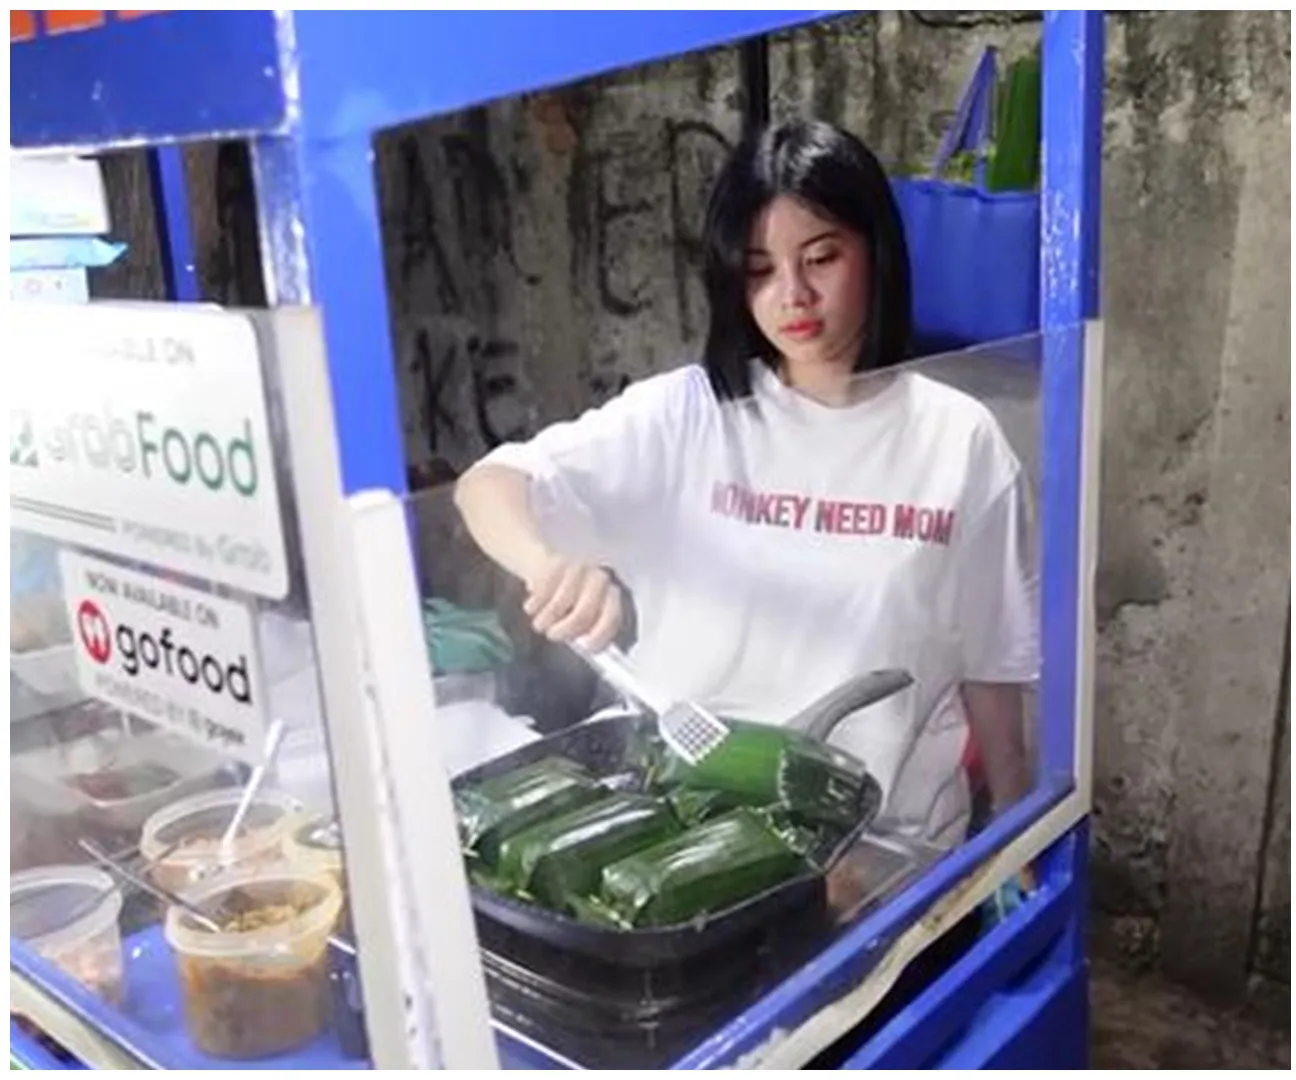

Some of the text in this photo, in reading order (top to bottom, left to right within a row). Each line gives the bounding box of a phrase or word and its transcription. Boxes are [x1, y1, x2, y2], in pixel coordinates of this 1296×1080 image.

[814, 499, 888, 535] NEED
[892, 504, 956, 545] MOM
[195, 600, 221, 630] ON
[115, 622, 254, 706] gofood
